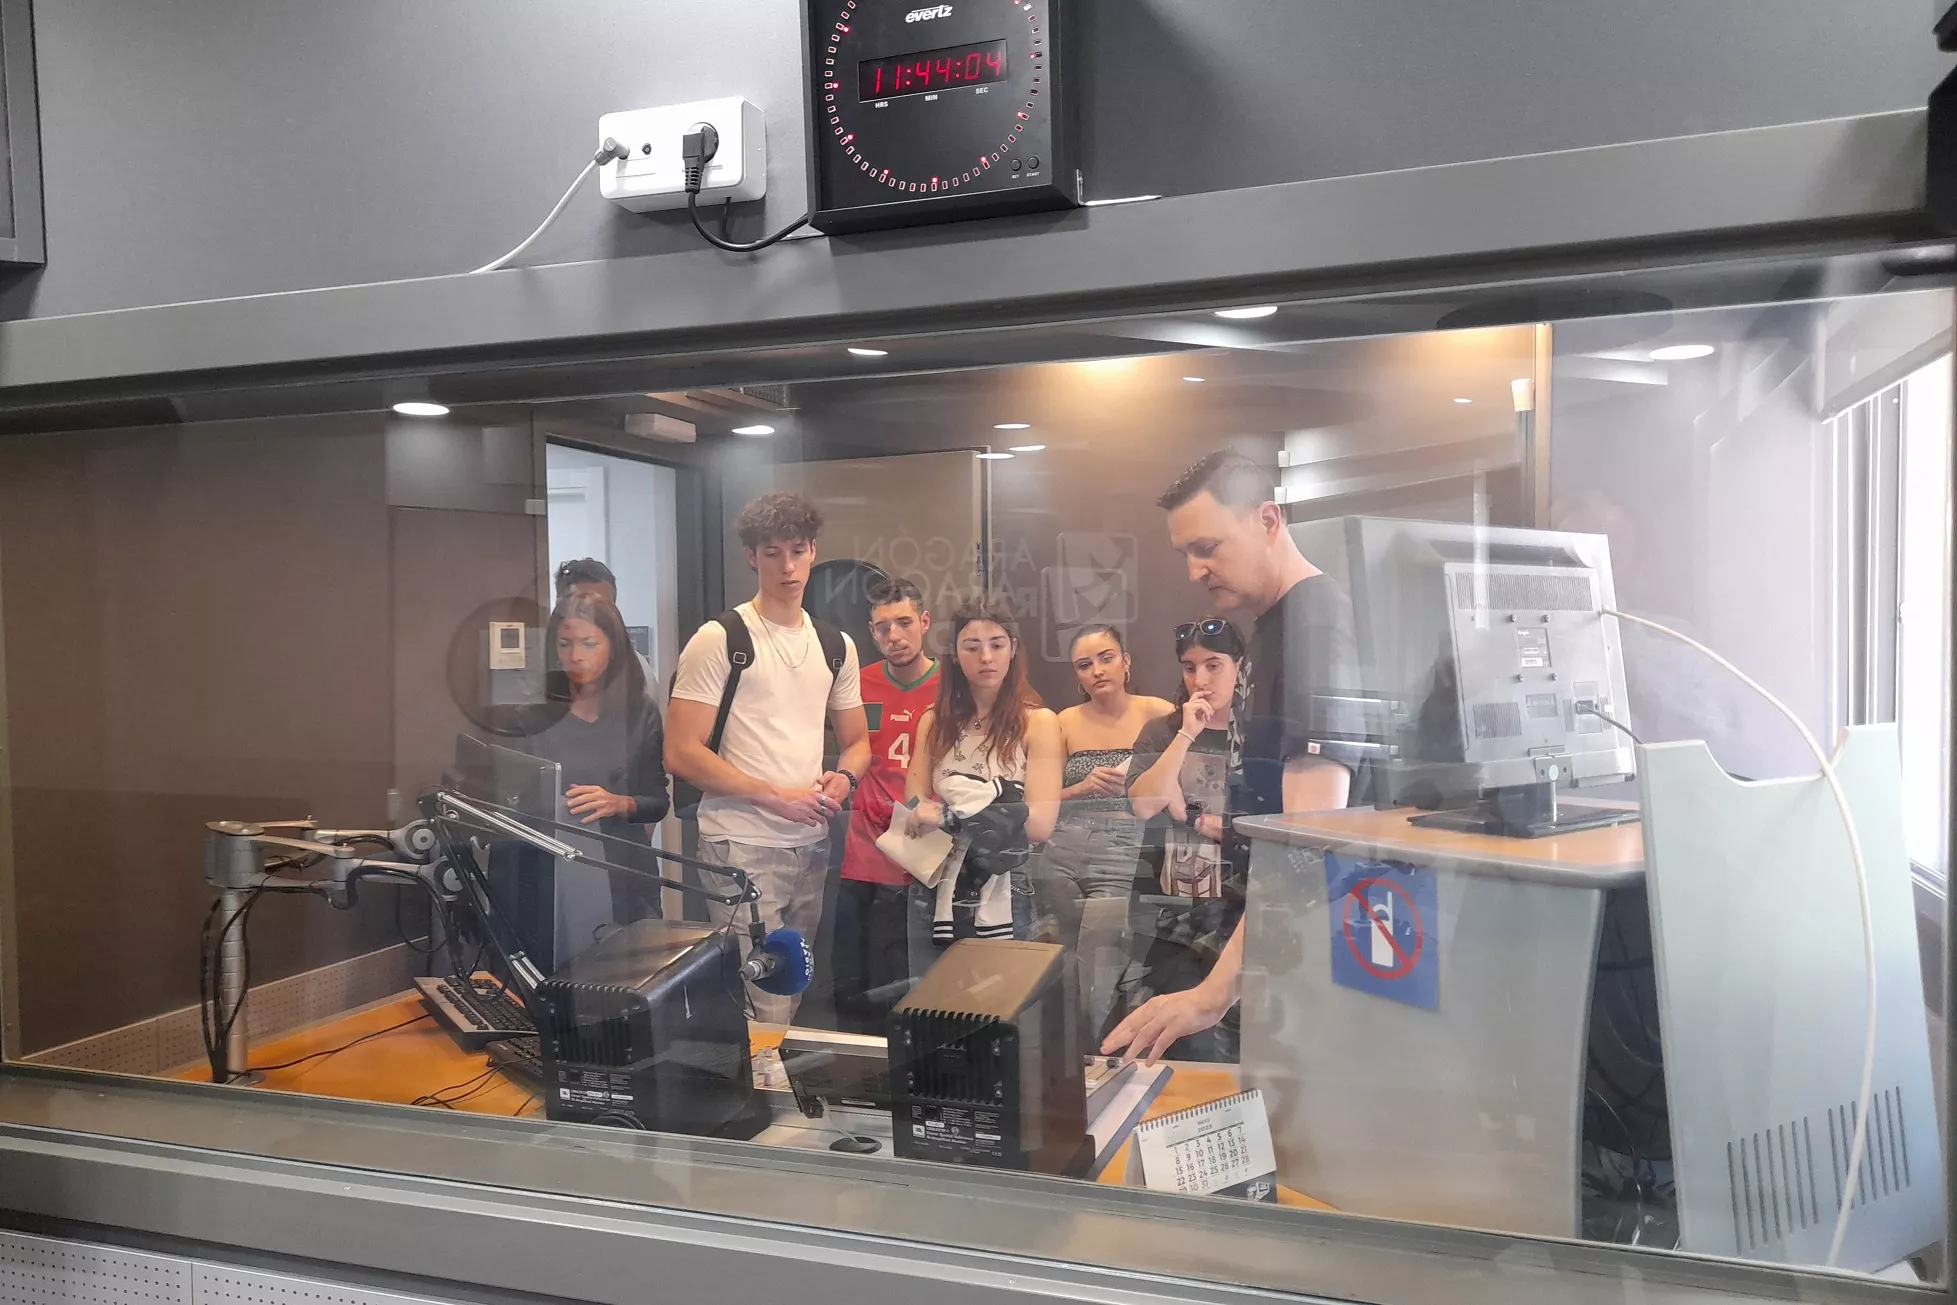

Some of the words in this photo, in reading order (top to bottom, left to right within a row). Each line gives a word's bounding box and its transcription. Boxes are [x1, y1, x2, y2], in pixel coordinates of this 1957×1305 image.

[905, 5, 953, 23] evertz
[874, 51, 1002, 93] 11:44:04
[975, 86, 989, 94] SEC
[888, 732, 911, 769] 4
[1208, 1146, 1213, 1154] 11
[1218, 1143, 1225, 1151] 12
[1228, 1139, 1235, 1147] 13
[1176, 1167, 1183, 1175] 15
[1186, 1163, 1194, 1171] 16
[1209, 1156, 1216, 1164] 18
[1229, 1149, 1238, 1157] 20
[1241, 1146, 1247, 1154] 21
[1177, 1177, 1185, 1186] 22
[1188, 1173, 1196, 1182] 23
[1199, 1170, 1207, 1178] 24
[1210, 1166, 1218, 1174] 25
[1221, 1162, 1229, 1171] 26
[1232, 1159, 1238, 1168] 27
[1241, 1155, 1249, 1164] 28
[1190, 1184, 1198, 1192] 30
[1201, 1180, 1208, 1188] 31
